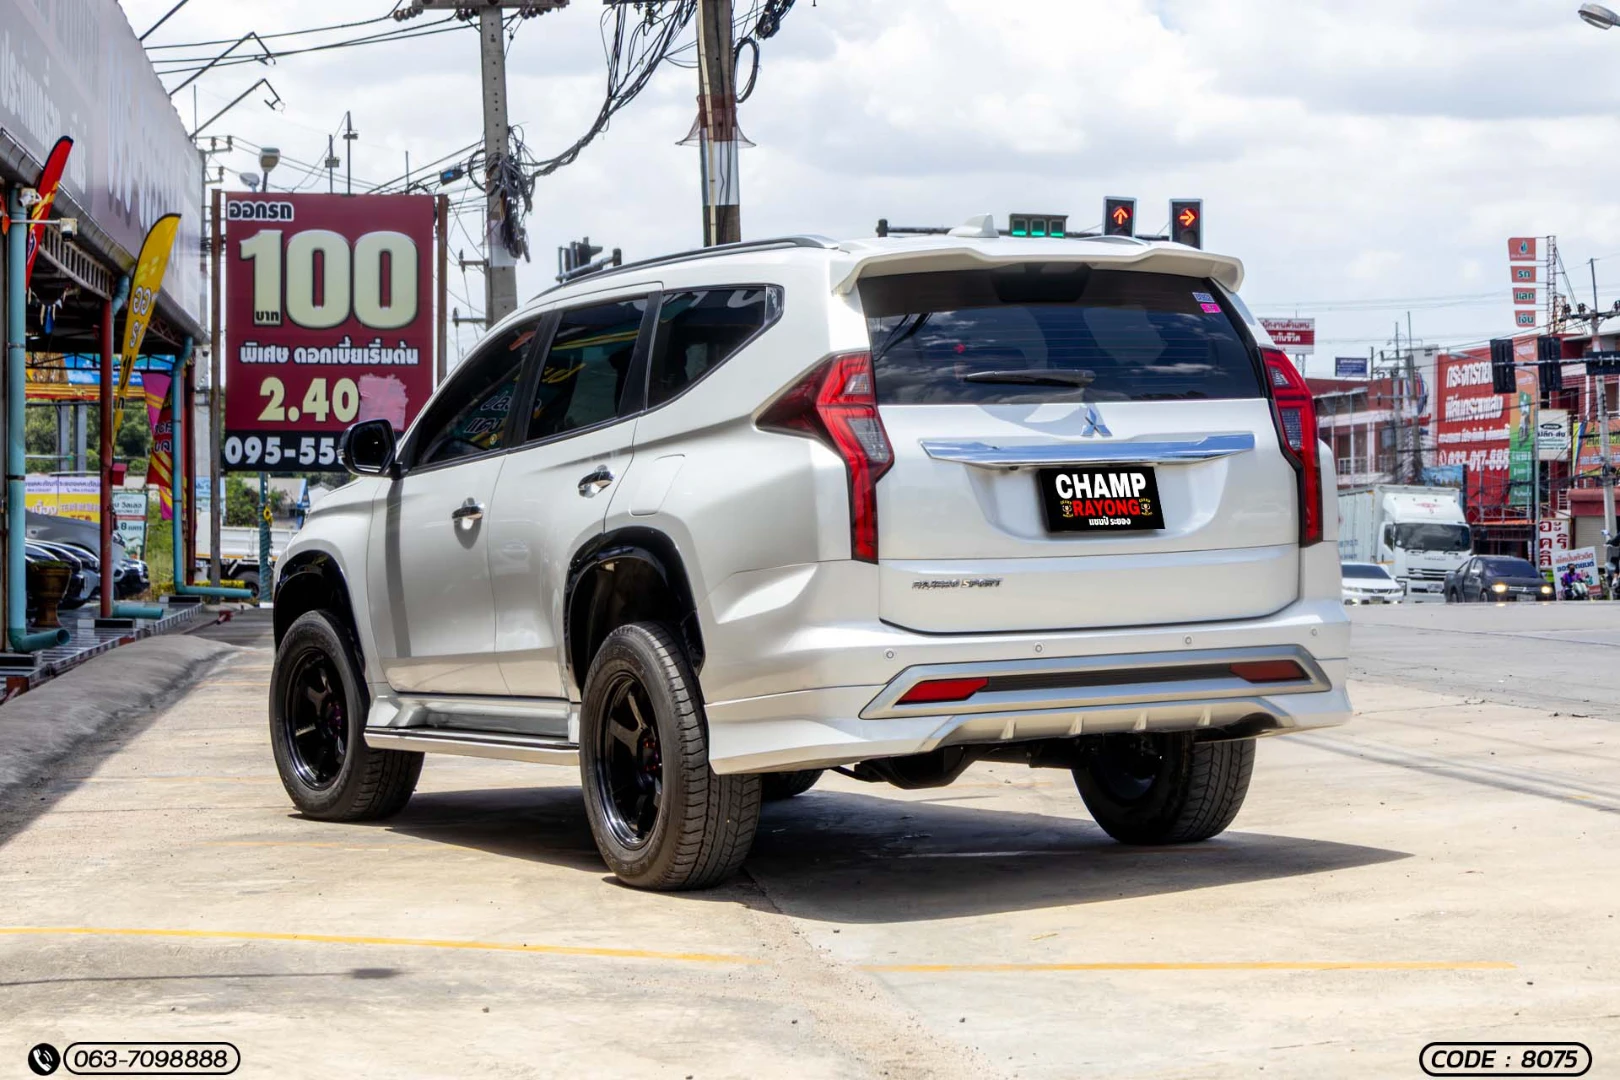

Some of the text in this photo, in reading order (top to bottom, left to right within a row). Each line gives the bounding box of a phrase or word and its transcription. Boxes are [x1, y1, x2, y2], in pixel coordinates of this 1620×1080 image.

[227, 200, 294, 222] ออกรถ
[239, 229, 418, 329] 100
[255, 310, 280, 322] บาท
[240, 336, 419, 365] พิเศษ ดอกเบี้ยเริ่มต้น
[257, 376, 360, 424] 2.40
[224, 435, 343, 466] 095-55
[1055, 473, 1147, 499] CHAMP
[1072, 499, 1141, 517] RAYONG
